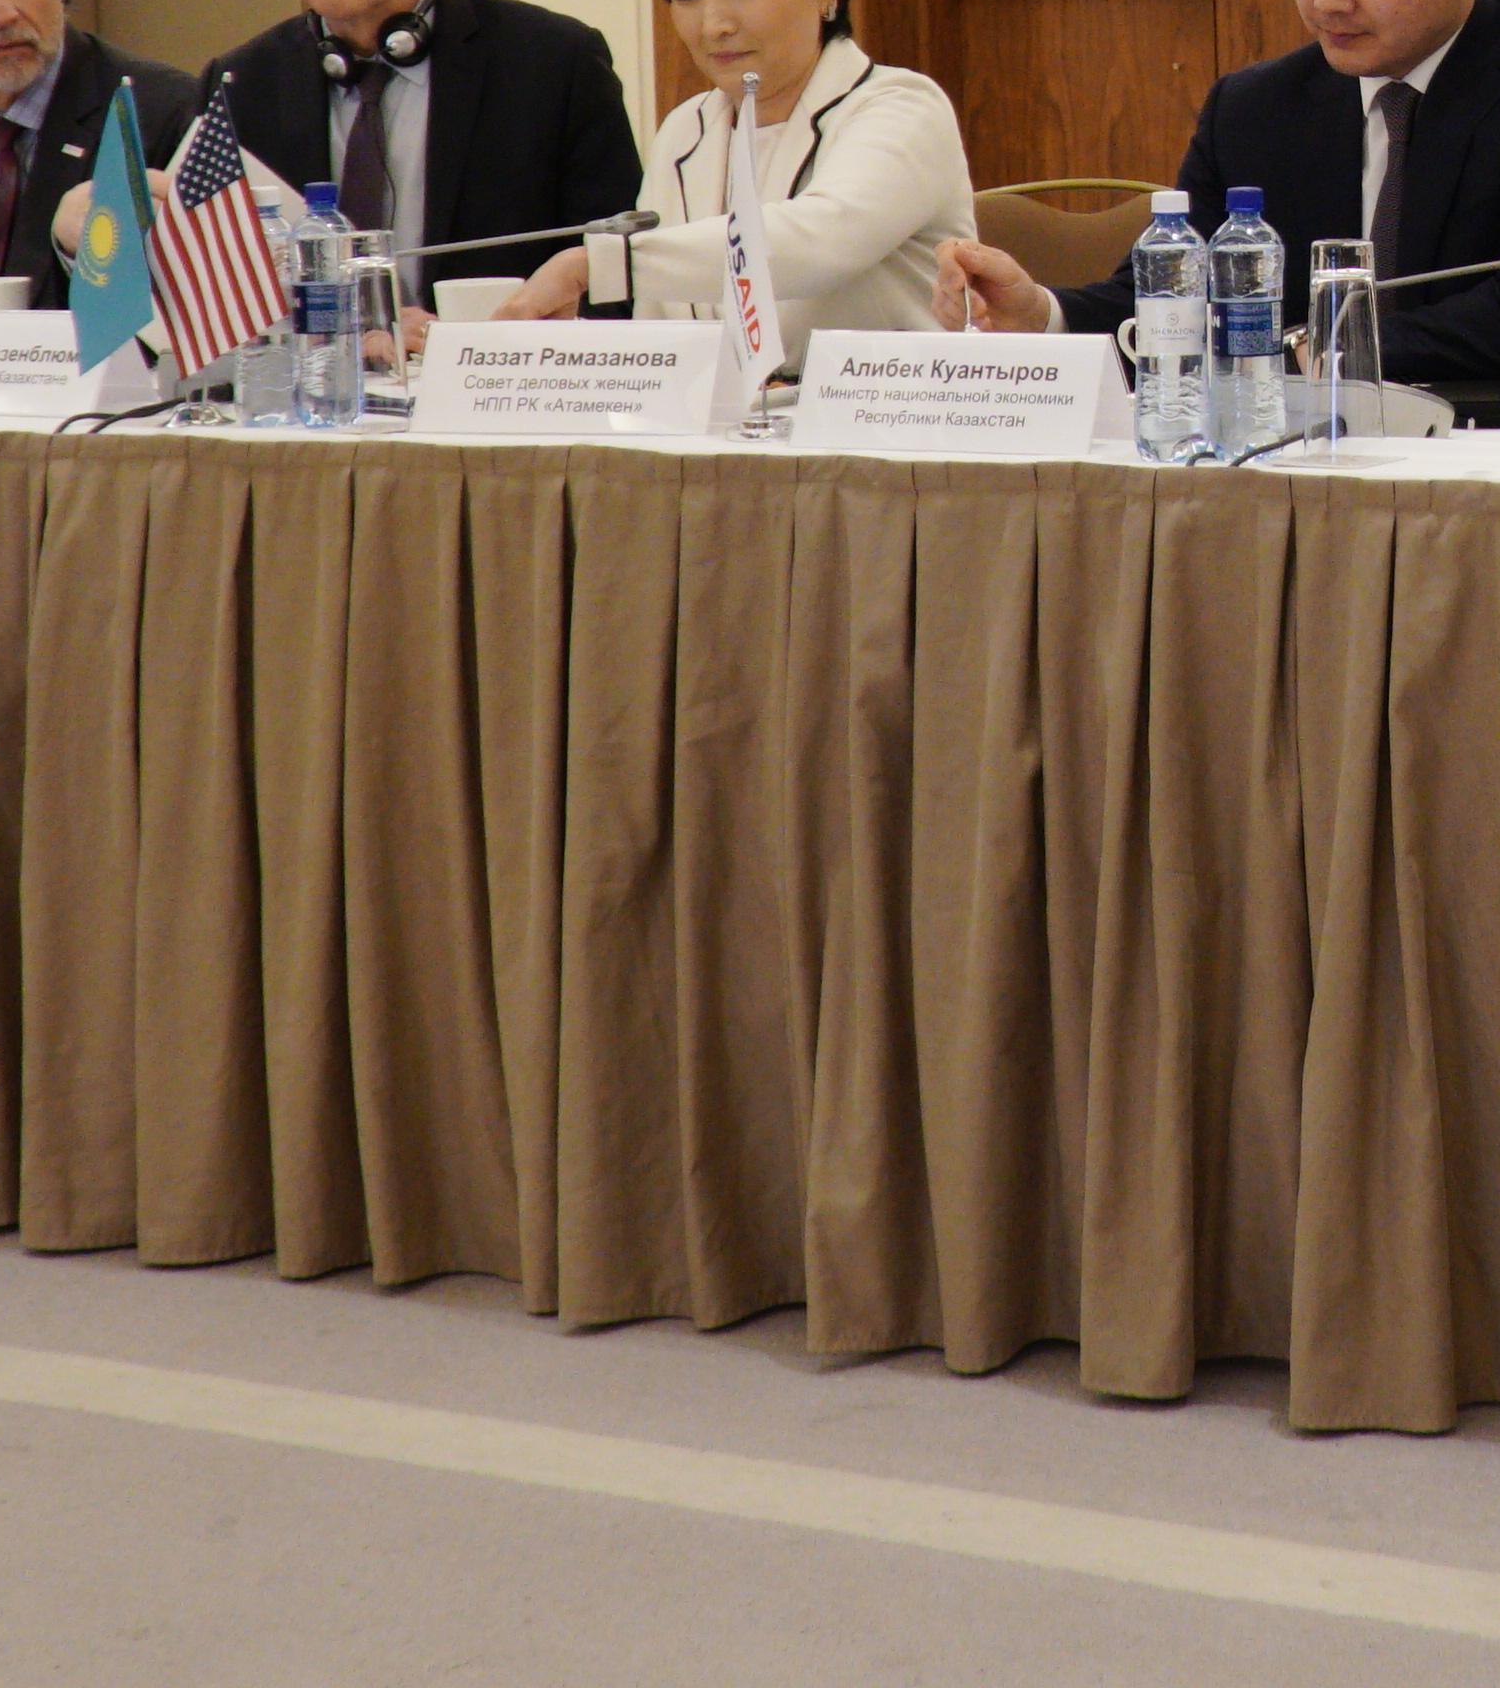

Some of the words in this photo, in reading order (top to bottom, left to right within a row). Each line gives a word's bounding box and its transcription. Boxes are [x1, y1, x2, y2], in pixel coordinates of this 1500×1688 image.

[727, 210, 761, 353] USAID
[457, 347, 534, 366] Лаззат
[539, 347, 678, 367] Рамазанова
[840, 358, 924, 379] Алибек
[930, 359, 1059, 385] Куантыров
[463, 374, 514, 390] Совет
[517, 376, 589, 392] деловых
[593, 377, 662, 393] женщин
[473, 397, 511, 412] НПП
[516, 397, 541, 412] РК
[543, 397, 642, 413] «Атамекен»
[818, 385, 880, 403] Министр
[884, 387, 990, 404] национальной
[994, 391, 1074, 406] экономики
[854, 409, 941, 427] Республики
[945, 411, 1026, 428] Казахстан
